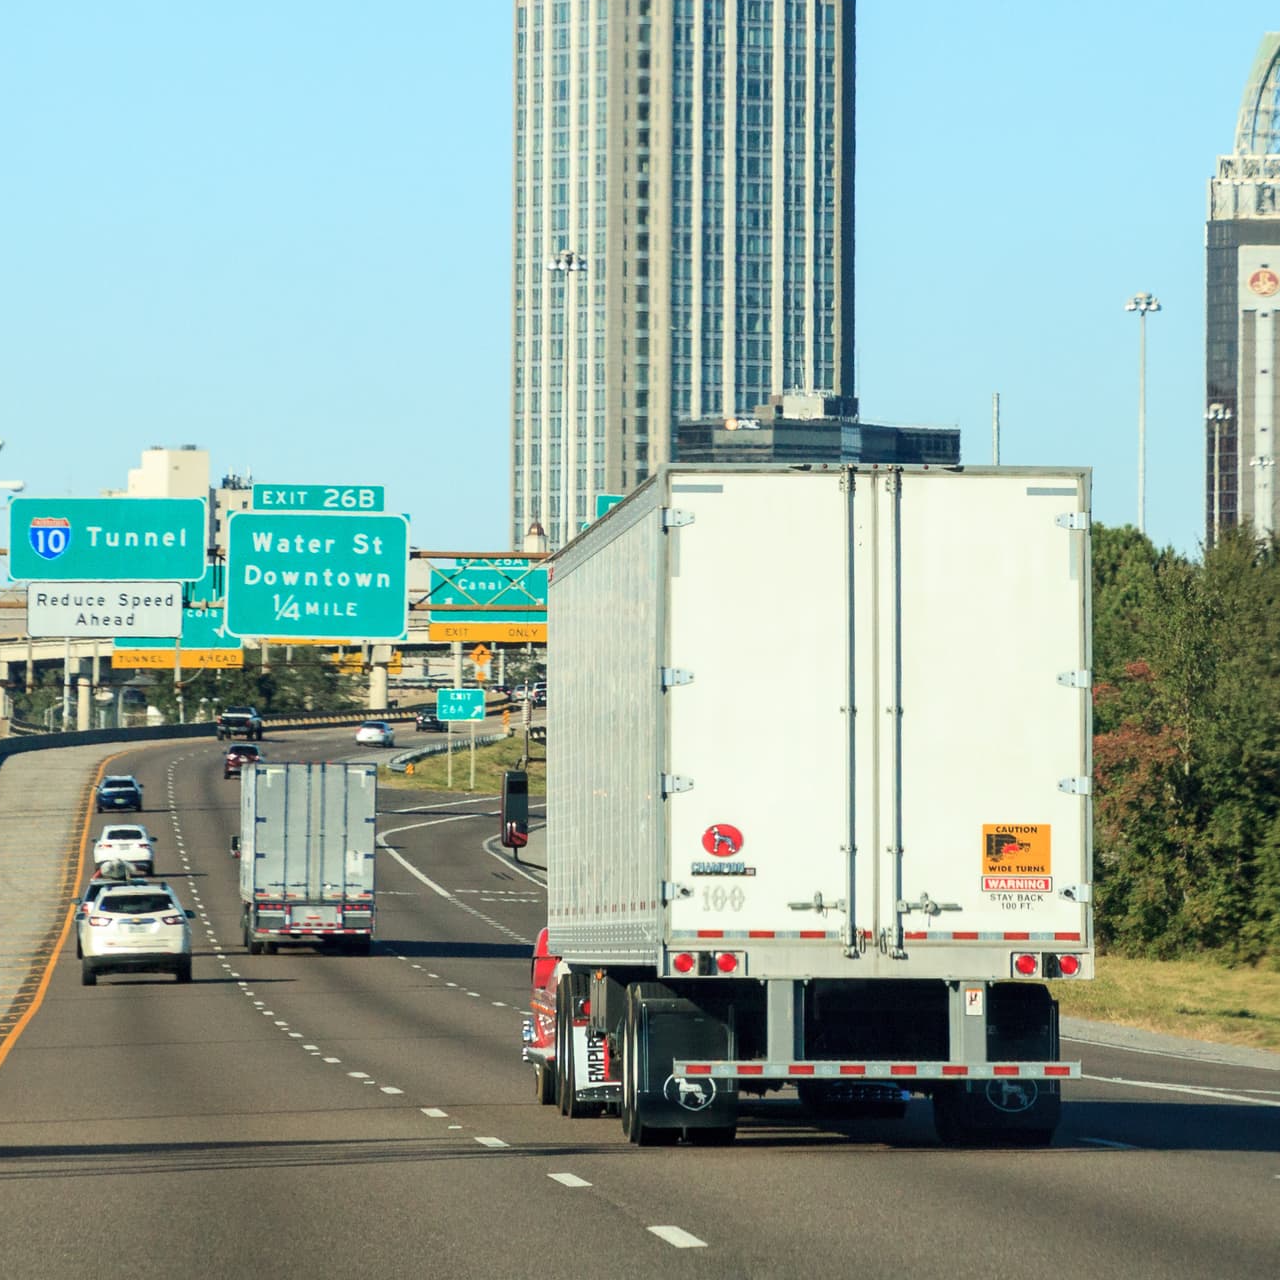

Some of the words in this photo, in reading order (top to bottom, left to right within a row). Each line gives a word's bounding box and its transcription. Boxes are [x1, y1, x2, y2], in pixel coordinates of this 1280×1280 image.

[262, 491, 308, 505] EXIT
[323, 488, 375, 508] 26B
[36, 529, 66, 553] 10
[86, 526, 187, 547] Tunnel
[252, 532, 336, 554] Water
[352, 533, 384, 555] St
[244, 564, 391, 588] Downtown
[457, 578, 503, 591] Canal
[36, 593, 106, 607] Reduce
[118, 593, 174, 609] Speed
[305, 602, 358, 617] MILE
[75, 613, 135, 626] Ahead
[444, 627, 469, 637] EXIT
[508, 627, 538, 637] ONLY
[119, 654, 164, 663] TUNNEL
[199, 654, 237, 663] AHEAD
[449, 692, 472, 701] EXIT
[441, 704, 464, 714] 26A
[995, 825, 1038, 834] CAUTION
[988, 865, 1012, 873] WIDE
[1016, 865, 1045, 873] TURNS
[987, 878, 1046, 890] WARNING
[990, 893, 1014, 902] STAY
[1017, 893, 1044, 902] BACK
[1001, 902, 1017, 910] 100
[587, 1034, 605, 1083] EMPIR
